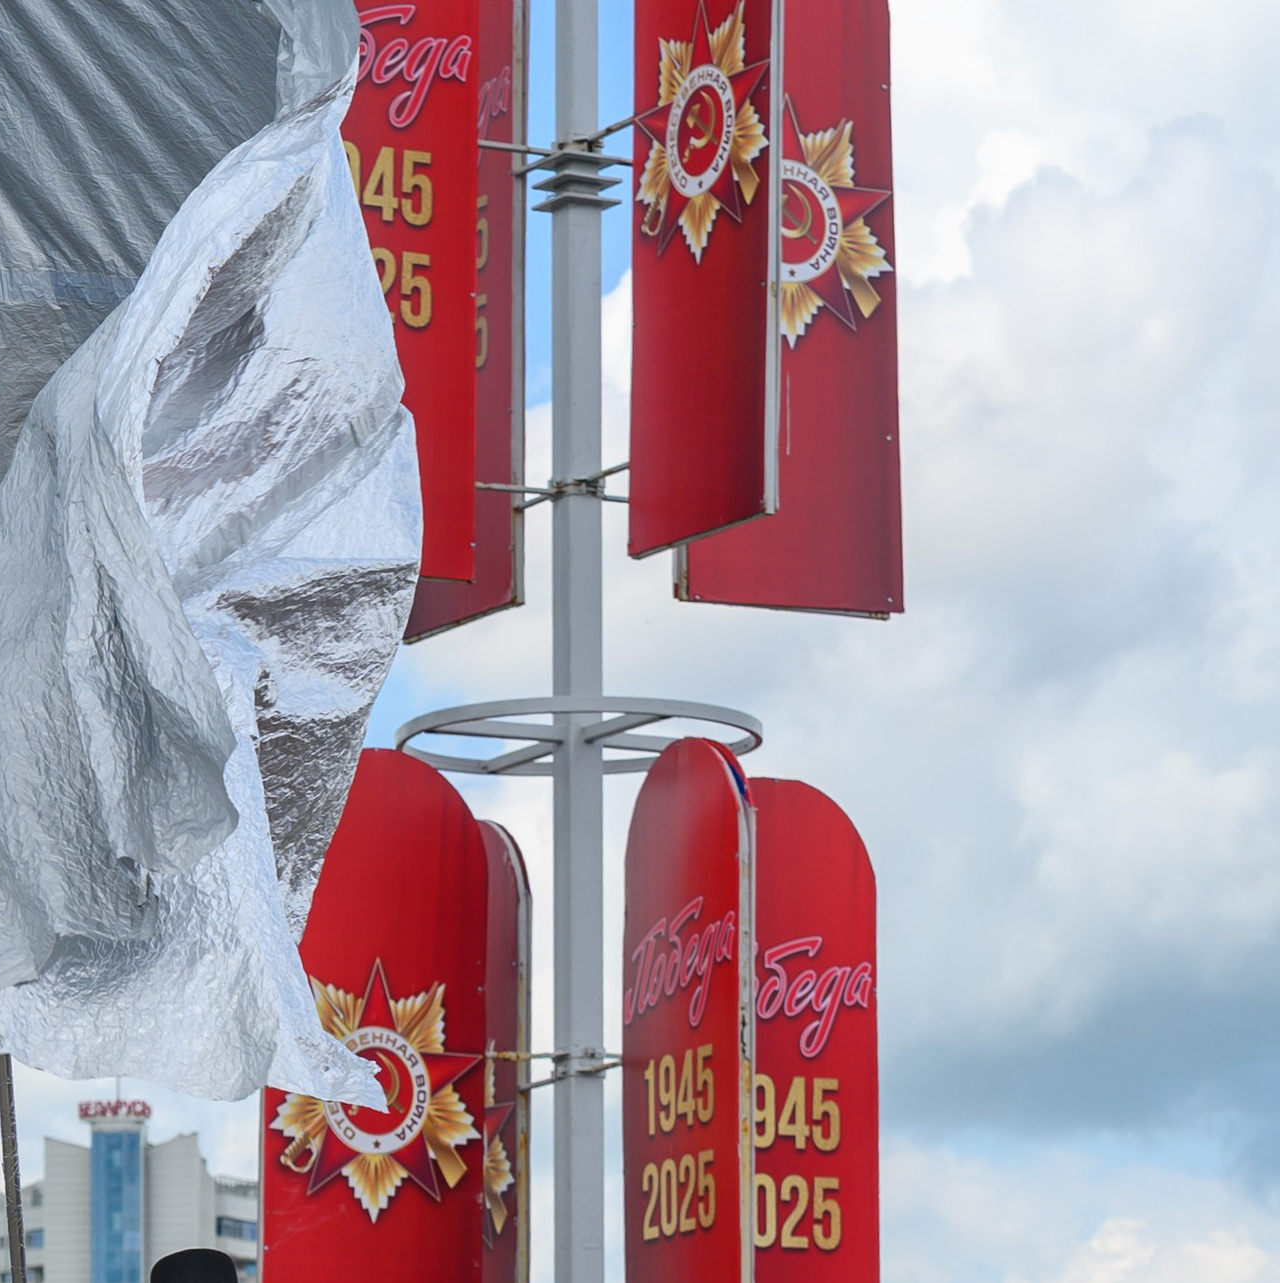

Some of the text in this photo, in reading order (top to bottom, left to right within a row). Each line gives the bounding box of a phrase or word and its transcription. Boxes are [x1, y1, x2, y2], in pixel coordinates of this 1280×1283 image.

[358, 5, 472, 128] беда
[343, 140, 433, 226] 45
[624, 896, 735, 1027] Победа
[755, 936, 872, 1057] беда
[327, 1032, 419, 1140] ОТЕВЕННАЯ
[644, 1043, 715, 1136] 1945
[754, 1073, 841, 1151] 945
[642, 1149, 716, 1241] 2025
[754, 1173, 842, 1250] 025
